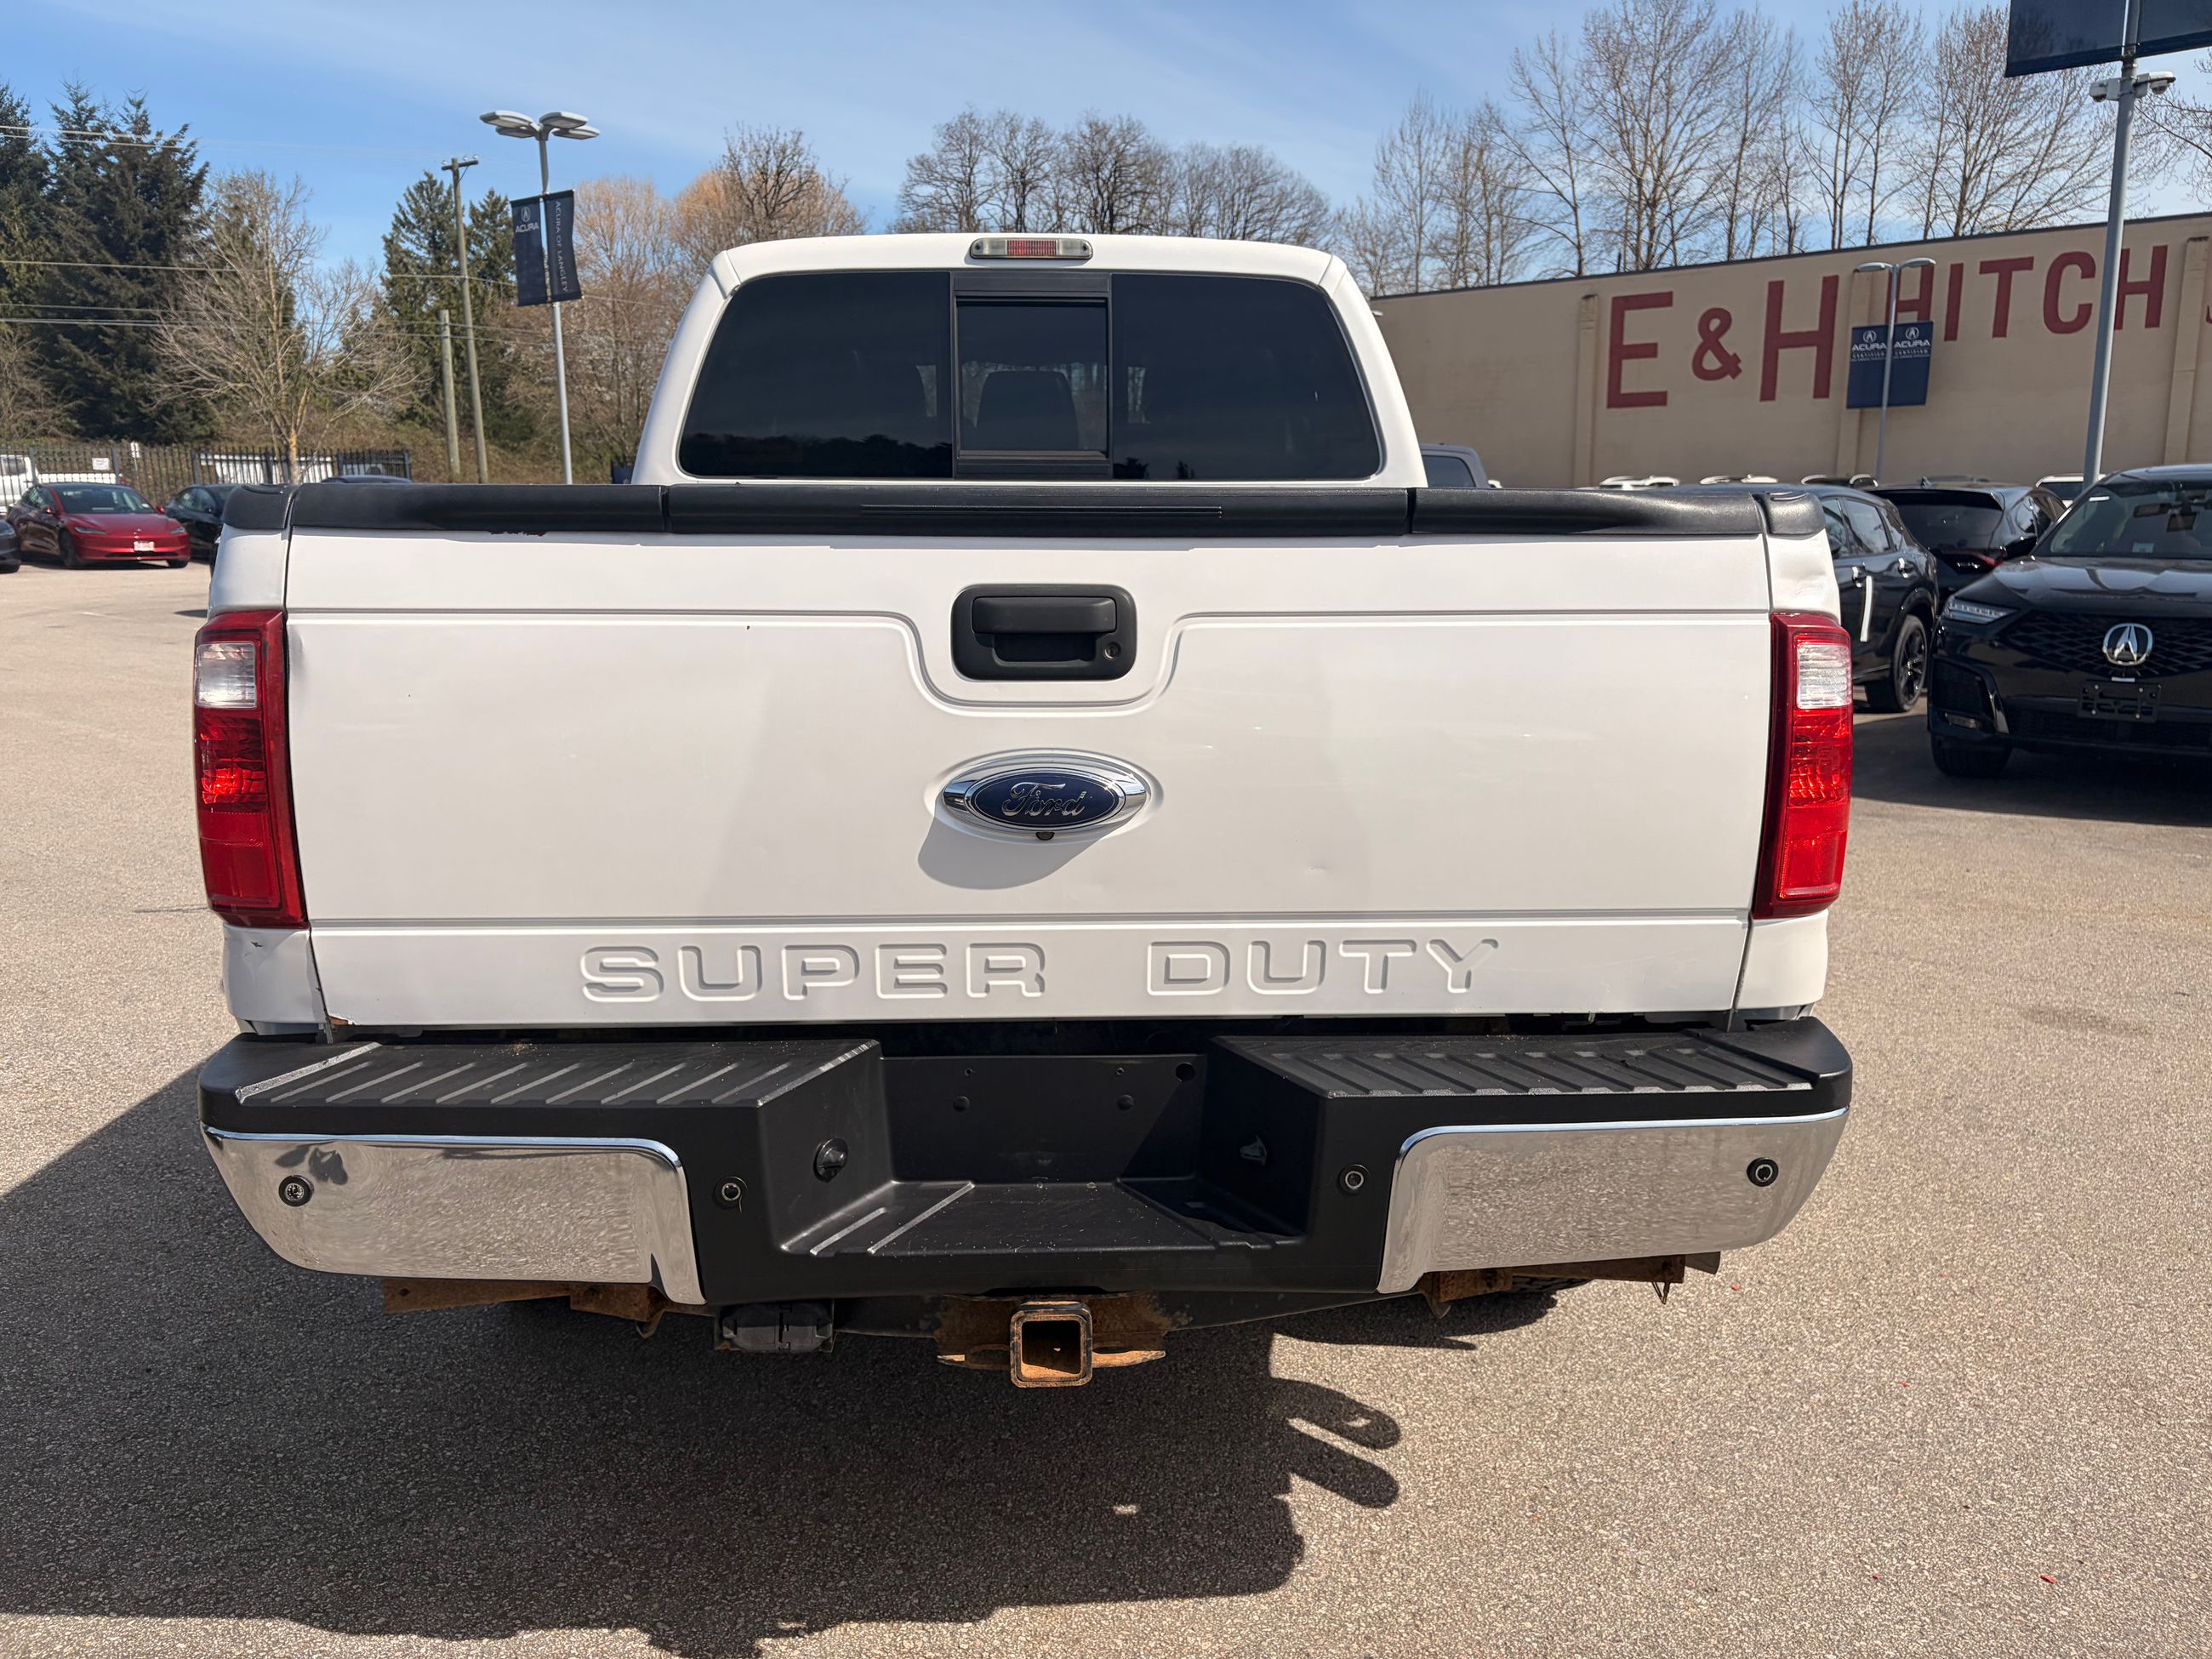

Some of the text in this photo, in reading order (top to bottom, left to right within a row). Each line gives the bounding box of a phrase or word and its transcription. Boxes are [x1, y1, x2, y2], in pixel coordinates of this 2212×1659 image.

[516, 222, 539, 233] ACURA
[556, 235, 562, 248] OF
[557, 250, 568, 292] LANGLEY
[1884, 245, 2168, 341] HITCH
[1852, 342, 1887, 351] ACURA
[1894, 339, 1930, 349] ACURA
[1001, 781, 1086, 817] Ford
[580, 938, 1499, 1002] SUPER DUTY
